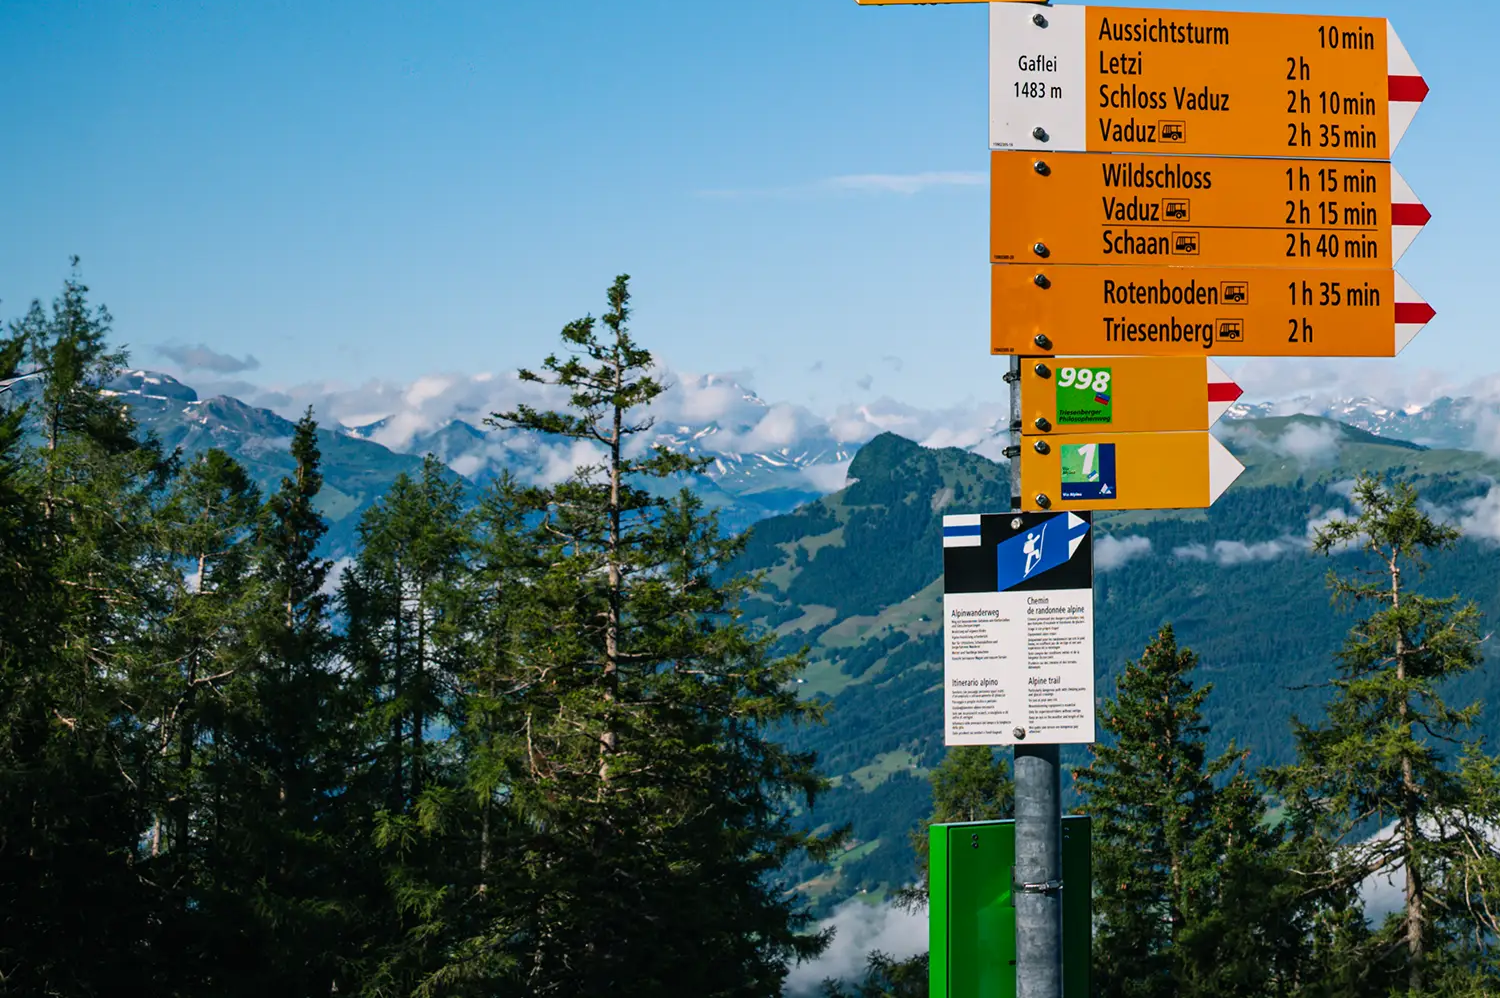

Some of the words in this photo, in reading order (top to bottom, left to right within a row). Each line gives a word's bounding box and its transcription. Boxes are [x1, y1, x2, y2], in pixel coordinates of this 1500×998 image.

[1099, 17, 1230, 45] Aussichtsturm
[1018, 55, 1057, 73] Gaflei
[1099, 51, 1142, 76] Letzi
[1014, 81, 1046, 99] 1483
[1050, 86, 1062, 99] m
[1099, 84, 1168, 110] Schloss
[1173, 86, 1230, 112] Vaduz
[1099, 118, 1157, 143] Vaduz
[1102, 162, 1212, 190] Wildschloss
[1102, 196, 1160, 222] Vaduz
[1102, 230, 1170, 256] Schaan
[1103, 279, 1219, 305] Rotenboden
[1103, 317, 1214, 348] Triesenberg
[1058, 367, 1111, 393] 998
[1077, 444, 1096, 475] 1
[951, 608, 1000, 618] Alpinwanderweg
[1027, 597, 1049, 605] Chemin
[1036, 606, 1066, 614] randonnée
[1067, 605, 1085, 615] alpine
[952, 679, 979, 687] Itinerario
[980, 677, 999, 688] alpino
[1028, 676, 1048, 688] Alpine
[1048, 676, 1061, 685] trail
